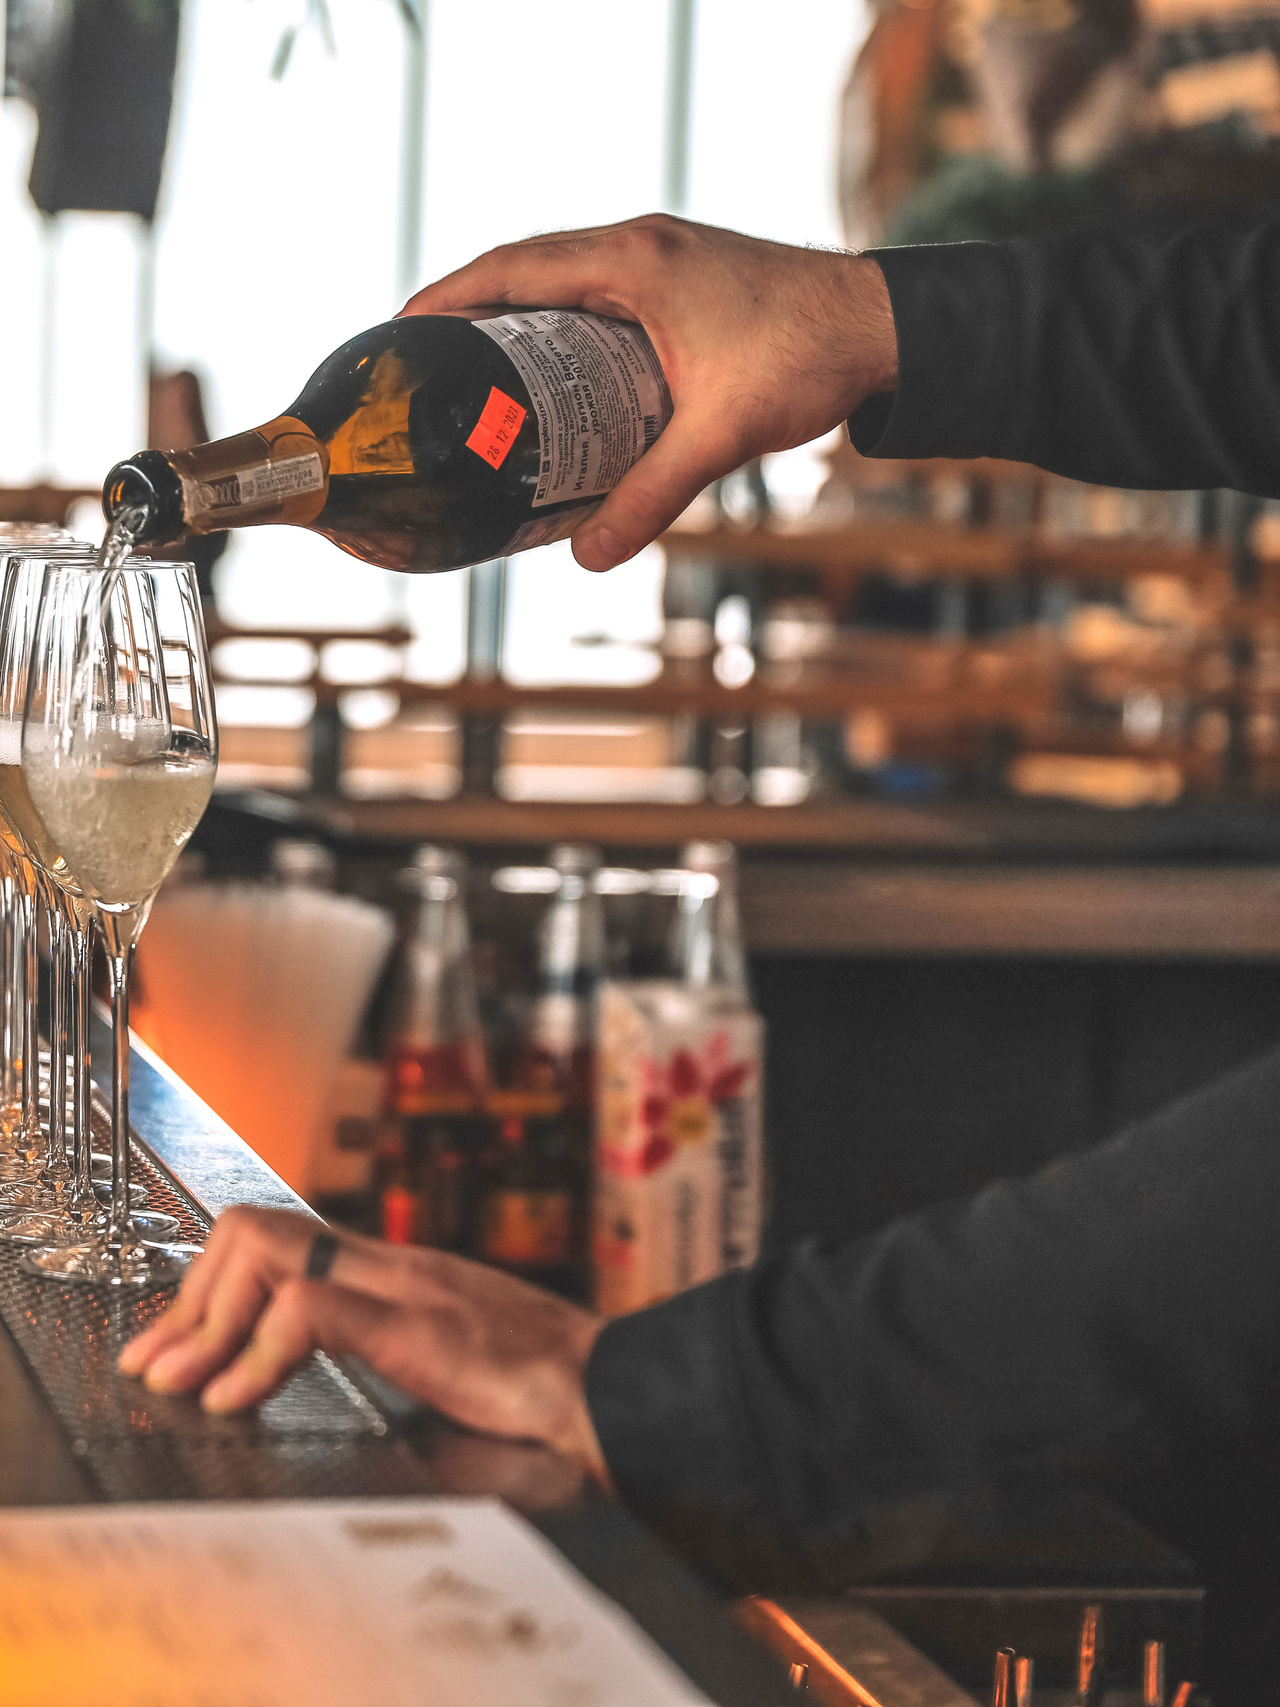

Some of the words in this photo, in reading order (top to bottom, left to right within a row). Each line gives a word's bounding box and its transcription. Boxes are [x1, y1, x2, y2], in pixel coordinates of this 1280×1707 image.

[522, 319, 544, 335] Год
[535, 353, 549, 373] сухое
[545, 336, 575, 381] Венето.
[565, 353, 587, 380] 2019
[547, 375, 560, 398] белое
[496, 429, 509, 443] 12
[503, 405, 519, 429] 2021
[572, 384, 590, 433] Регион
[582, 384, 601, 436] урожая
[536, 400, 550, 457] simplewine
[552, 470, 561, 490] Вино
[573, 437, 590, 491] Италия.
